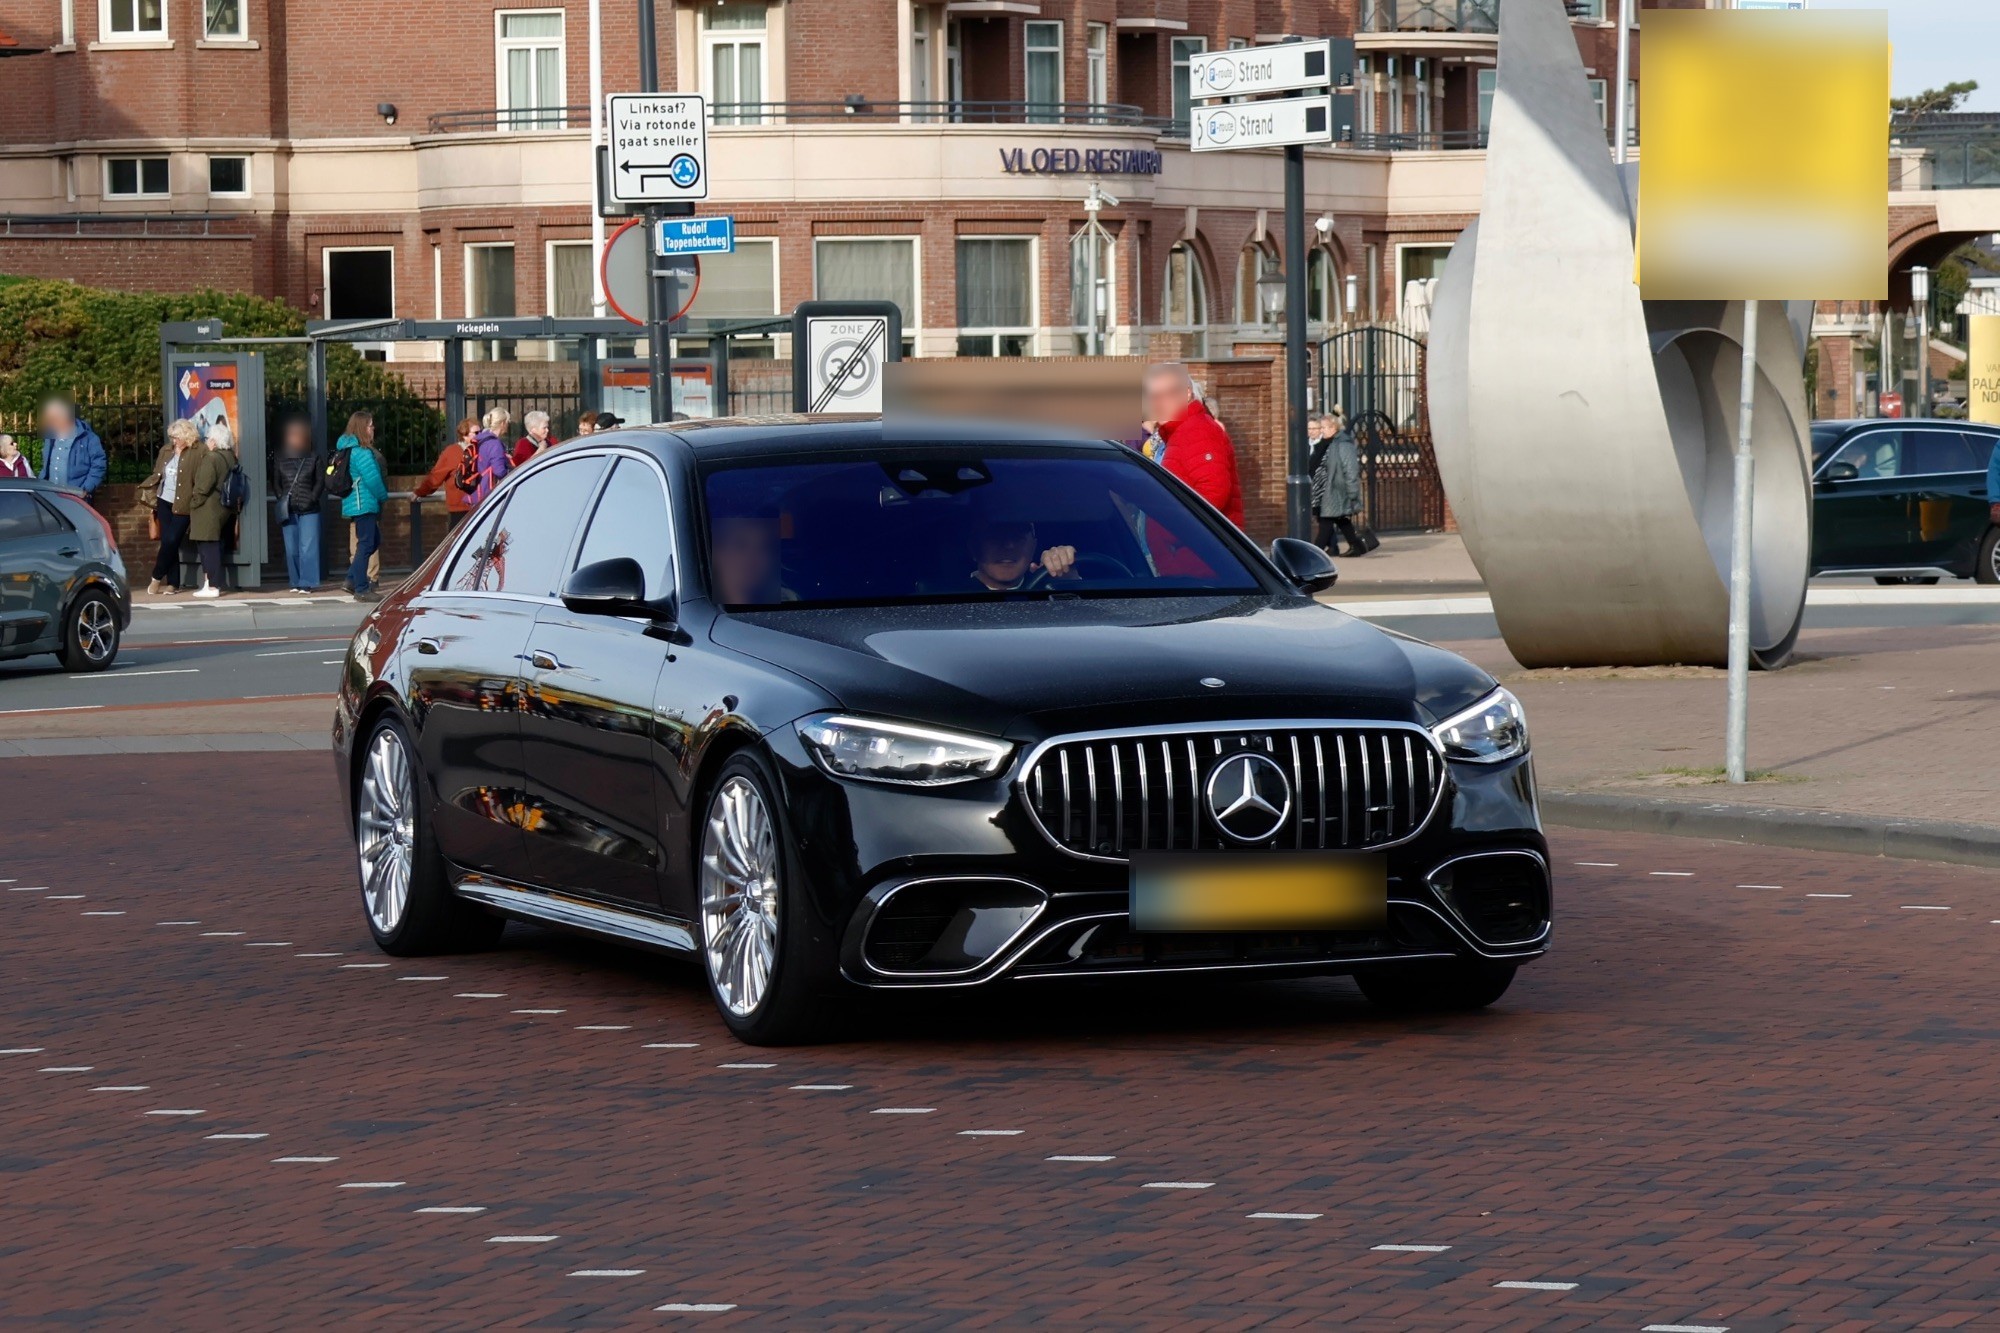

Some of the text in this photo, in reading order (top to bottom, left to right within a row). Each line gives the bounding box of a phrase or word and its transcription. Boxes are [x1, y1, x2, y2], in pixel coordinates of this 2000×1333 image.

[1239, 58, 1272, 82] Strand
[629, 102, 686, 114] Linksaf?
[619, 119, 696, 131] Via rotonde
[1240, 113, 1273, 136] Strand
[619, 135, 699, 150] gaat sneller
[999, 147, 1080, 174] VLOED
[664, 221, 727, 251] Rudolf Tappenbeckweg
[456, 322, 500, 335] Pickeplein
[830, 325, 864, 335] ZONE
[829, 358, 867, 380] 30
[1986, 363, 2000, 373] VA
[1982, 390, 2000, 403] NO
